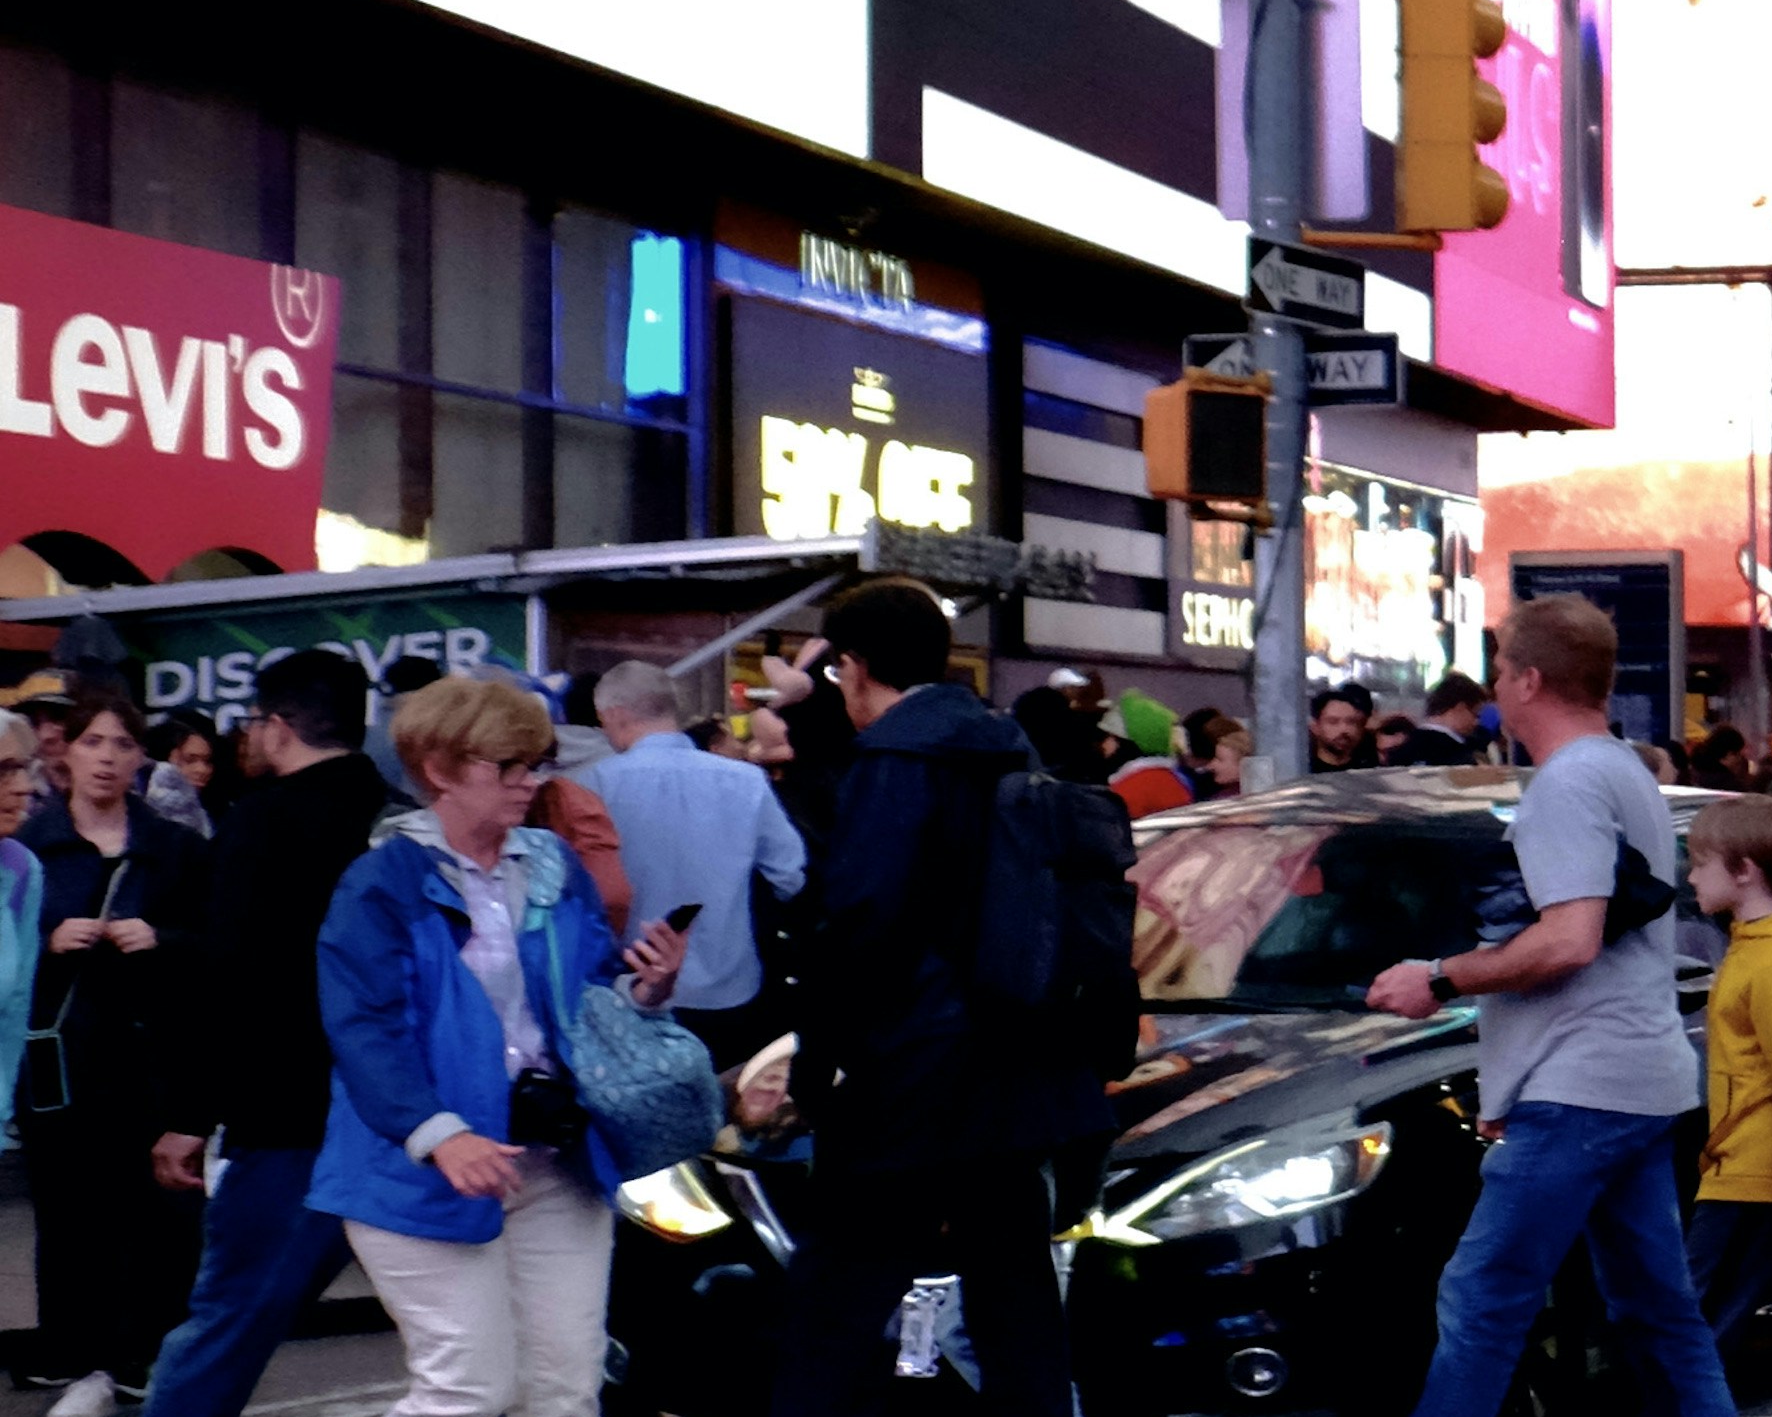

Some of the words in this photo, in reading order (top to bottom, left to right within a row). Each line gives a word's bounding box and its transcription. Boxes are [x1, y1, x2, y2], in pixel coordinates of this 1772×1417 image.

[1264, 262, 1300, 296] ONE
[1316, 279, 1350, 307] WAY
[1307, 354, 1369, 382] WAY
[145, 626, 492, 708] DISVER
